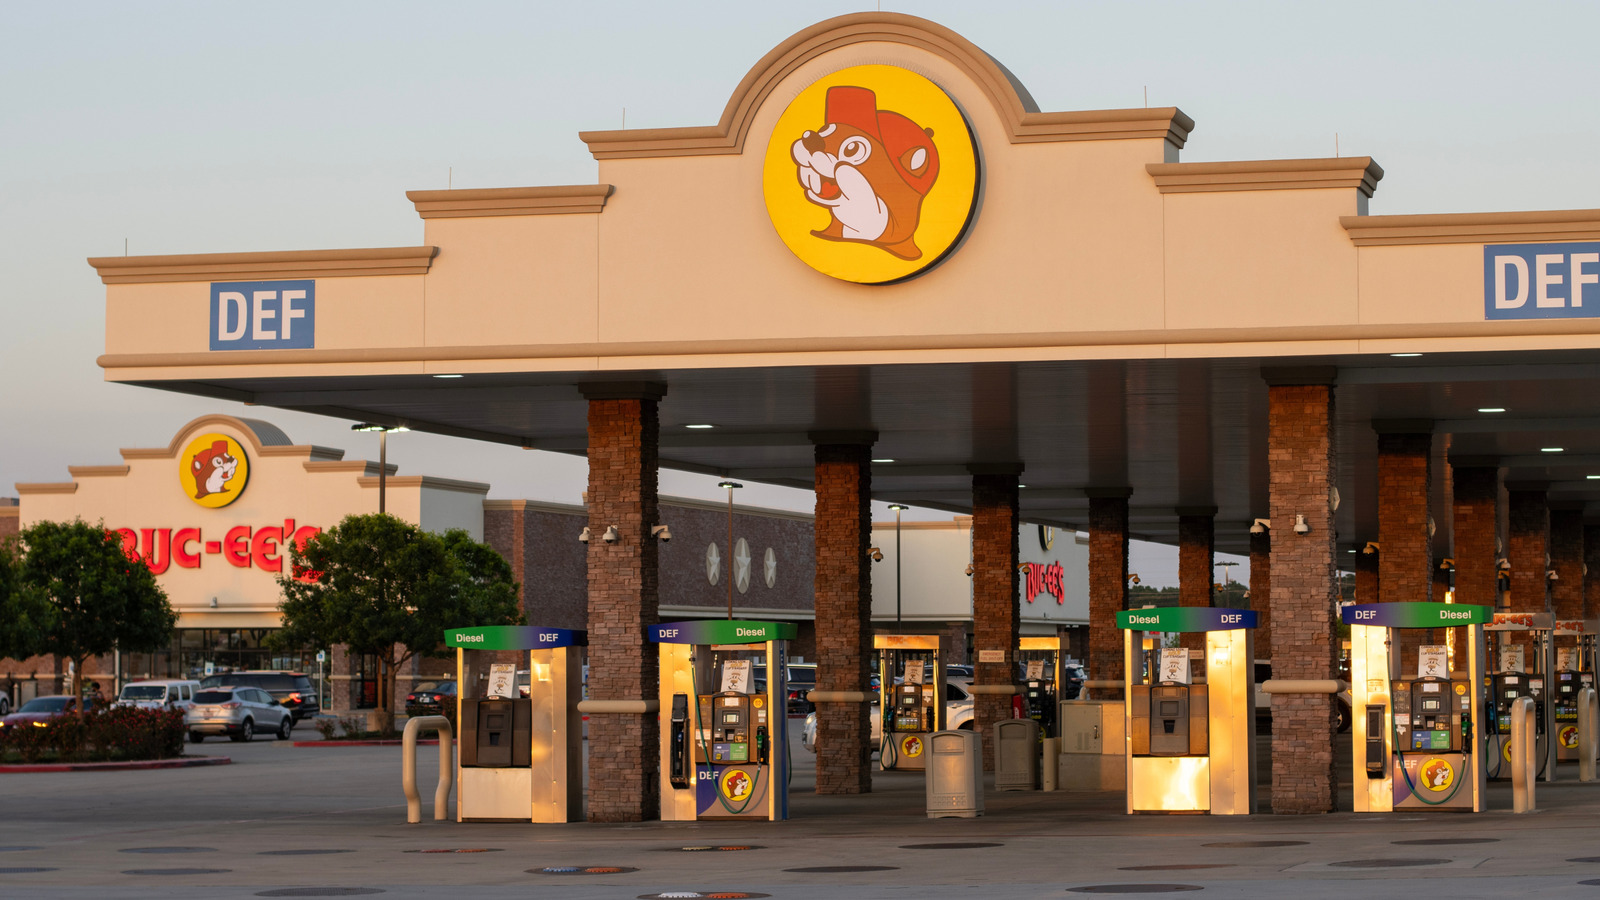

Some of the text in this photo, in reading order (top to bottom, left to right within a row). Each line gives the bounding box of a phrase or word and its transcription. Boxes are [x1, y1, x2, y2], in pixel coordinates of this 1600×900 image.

[1494, 252, 1600, 310] DEF
[218, 289, 307, 341] DEF
[1026, 560, 1065, 606] BUC-EE'S
[1128, 614, 1243, 624] Diesel DEF
[1354, 610, 1472, 620] DEF Diesel
[1485, 613, 1534, 627] UC-EE'S
[456, 633, 559, 643] Diesel DEF
[659, 628, 766, 638] DEF Diesel
[1395, 759, 1418, 769] DEF
[699, 771, 719, 780] DEF
